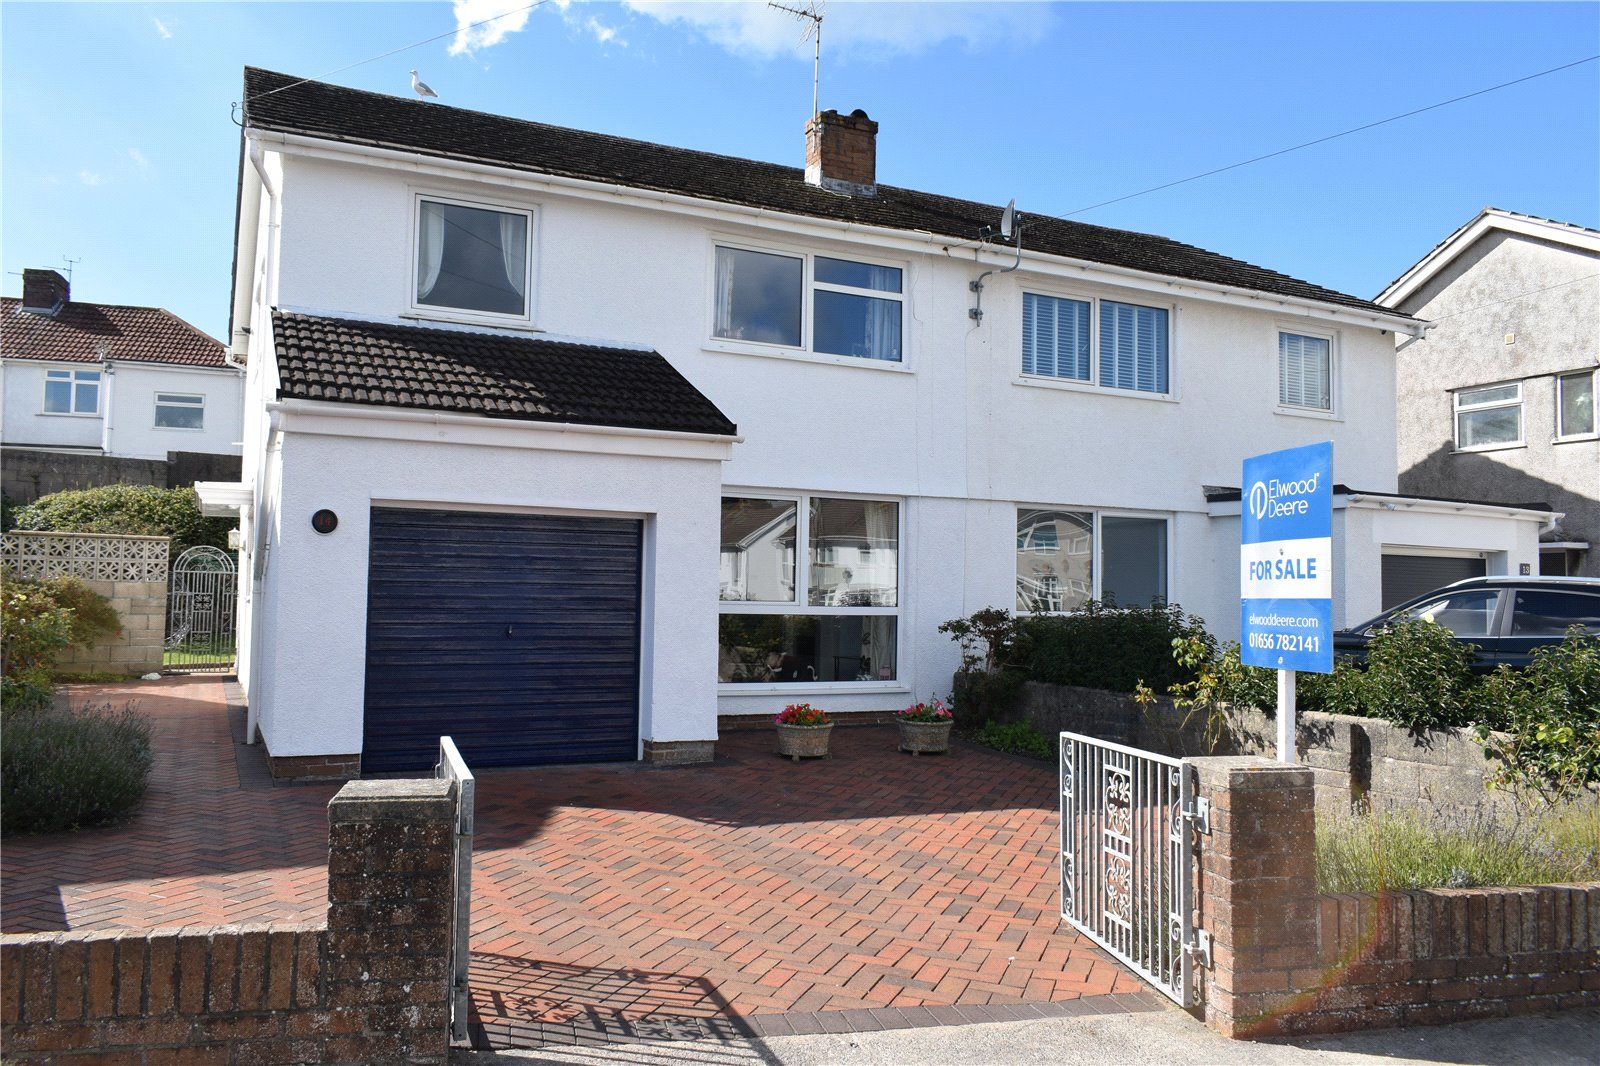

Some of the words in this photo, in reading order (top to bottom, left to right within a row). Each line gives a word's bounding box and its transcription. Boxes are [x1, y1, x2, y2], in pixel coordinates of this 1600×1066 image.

[1269, 472, 1318, 499] Elwood
[1268, 499, 1309, 518] Deere
[1249, 560, 1272, 581] FOR
[1275, 557, 1317, 580] SALE
[1249, 612, 1319, 628] elwooddeere.com
[1249, 632, 1274, 650] 01656
[1275, 634, 1319, 653] 782141
